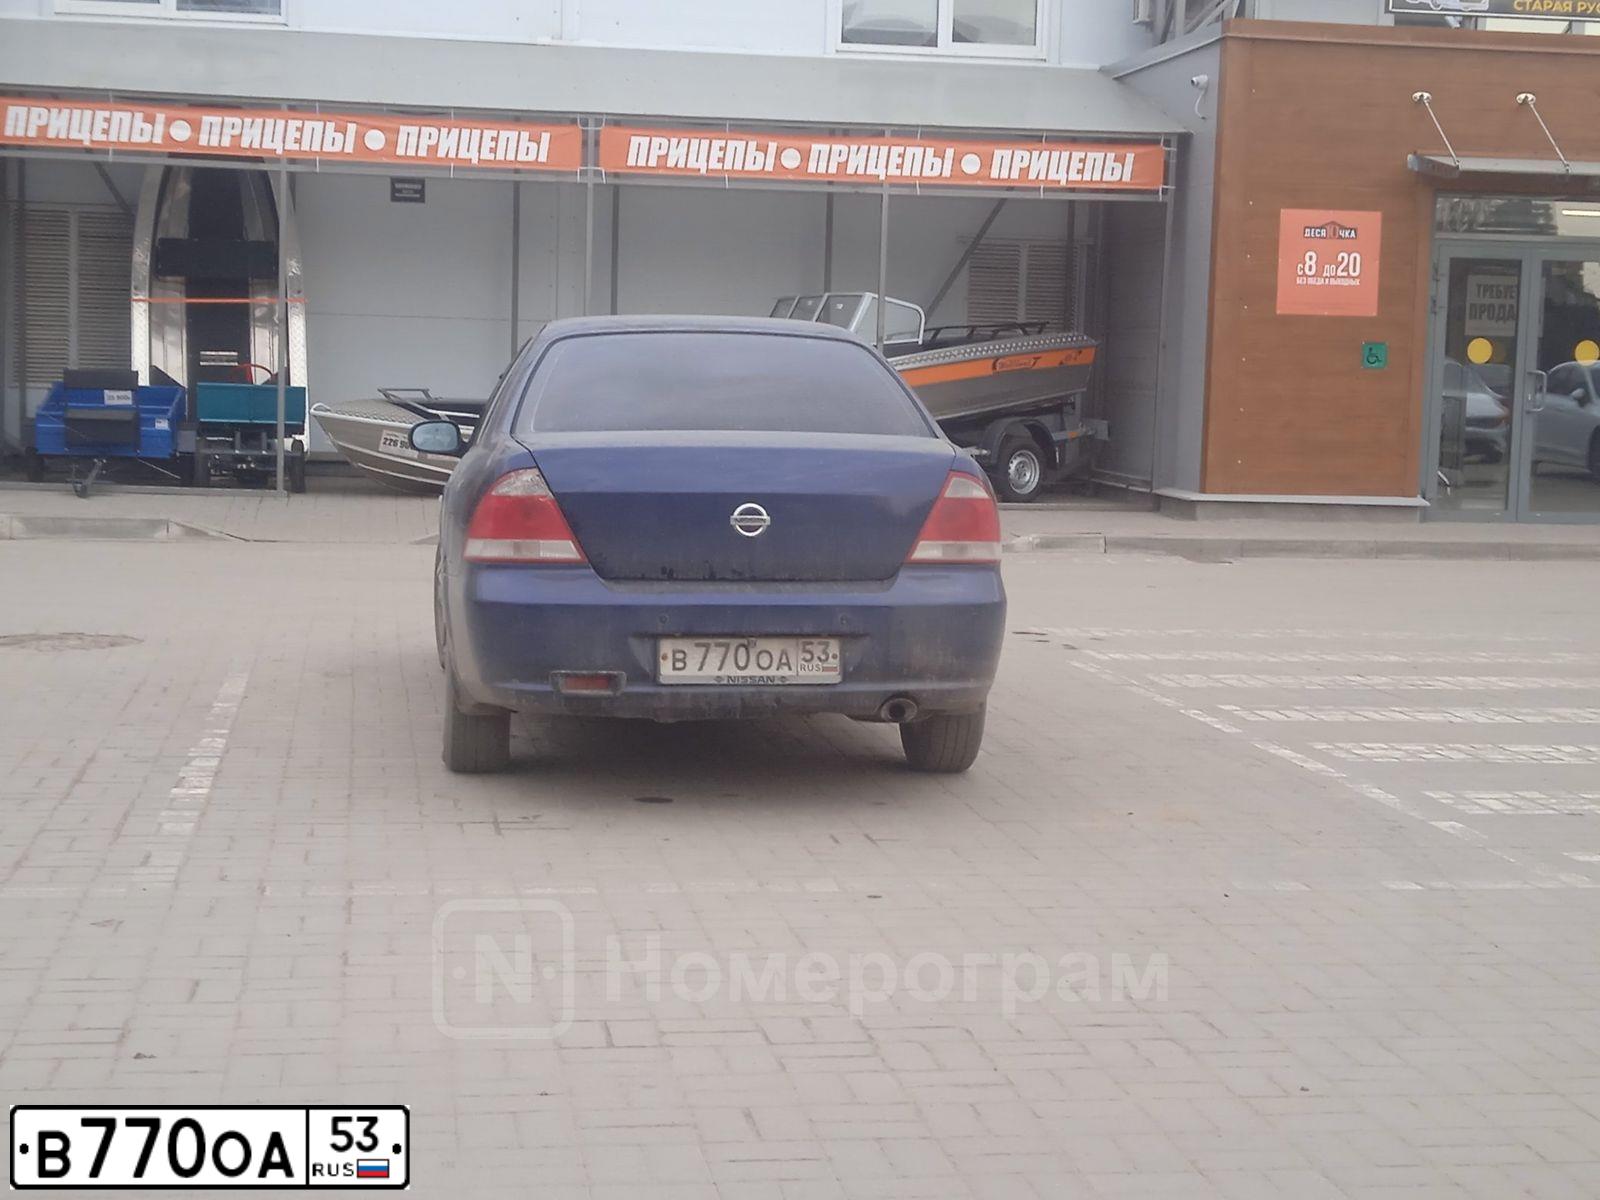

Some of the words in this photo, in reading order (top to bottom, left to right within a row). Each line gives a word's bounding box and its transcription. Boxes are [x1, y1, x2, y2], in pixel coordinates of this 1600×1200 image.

[1514, 0, 1572, 12] СТАРАЯ
[4, 105, 166, 146] ПРИЦЕПЫ
[198, 116, 357, 154] ПРИЦЕПЫ
[396, 125, 550, 165] ПРИЦЕПЫ
[626, 136, 777, 174] ПРИЦЕПЫ
[808, 143, 955, 180] ПРИЦЕПЫ
[990, 149, 1135, 186] ПРИЦЕПЫ
[1304, 251, 1317, 276] 8
[1336, 252, 1361, 277] 20
[671, 642, 793, 672] В770ОА
[801, 641, 830, 663] 53
[800, 663, 822, 672] RUS
[727, 674, 776, 684] NISSAN
